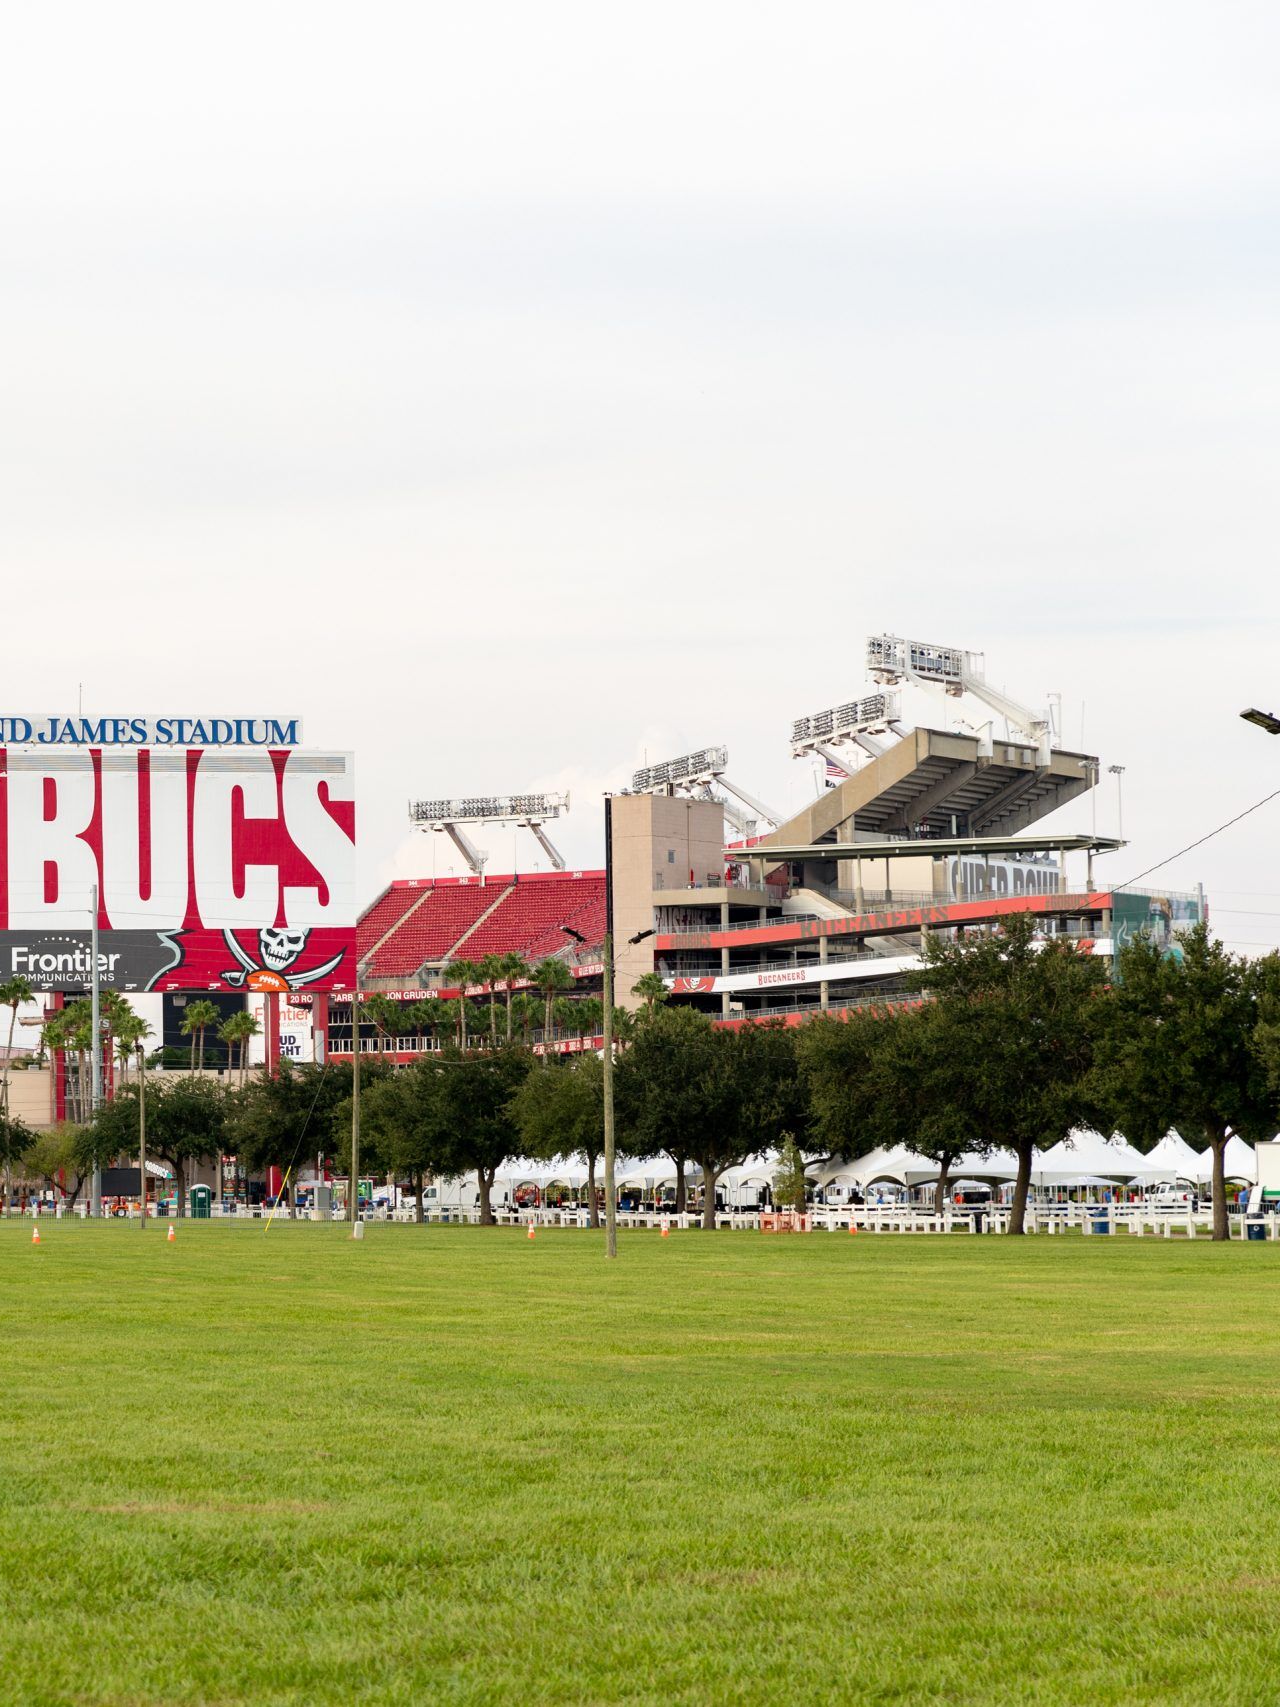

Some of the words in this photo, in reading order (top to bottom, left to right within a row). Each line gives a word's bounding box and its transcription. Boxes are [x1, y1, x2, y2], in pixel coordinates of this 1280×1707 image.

[37, 718, 148, 744] JAMES
[155, 718, 300, 745] STADIUM
[7, 747, 356, 930] BUCS
[11, 946, 121, 972] Frontier
[757, 970, 806, 986] BUCCANEERS
[290, 995, 299, 1004] 20
[385, 992, 402, 1000] JON
[403, 990, 438, 999] GRUDEN
